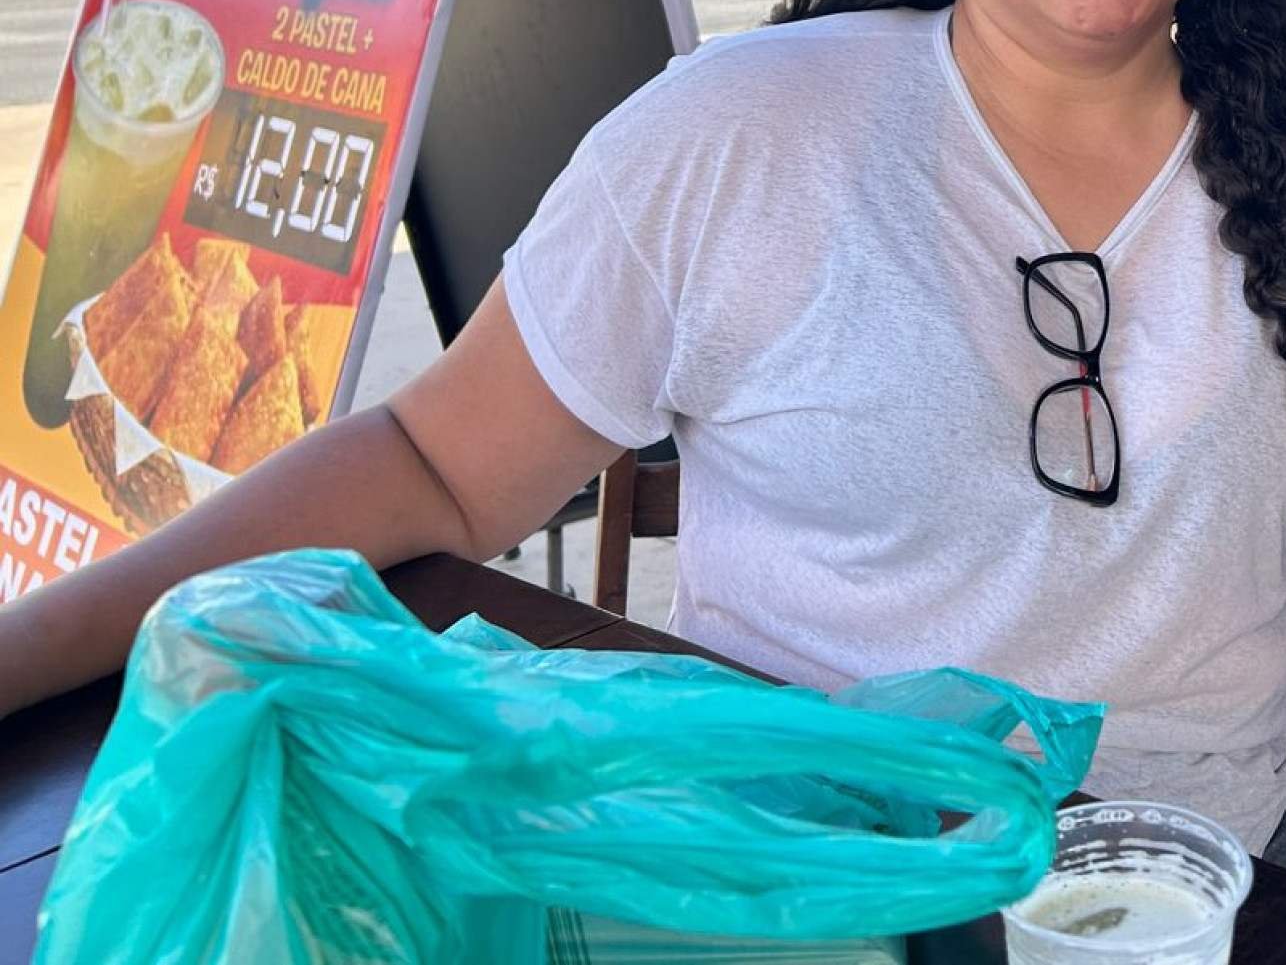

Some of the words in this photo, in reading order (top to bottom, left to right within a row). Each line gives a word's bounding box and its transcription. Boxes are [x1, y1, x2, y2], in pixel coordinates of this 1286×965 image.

[271, 5, 290, 41] 2
[290, 11, 360, 54] PASTEL
[236, 49, 302, 95] CALDO
[301, 65, 329, 102] DE
[330, 68, 388, 115] CANA
[193, 163, 220, 202] R$
[234, 113, 375, 243] 12,00
[0, 477, 100, 574] ASTEL
